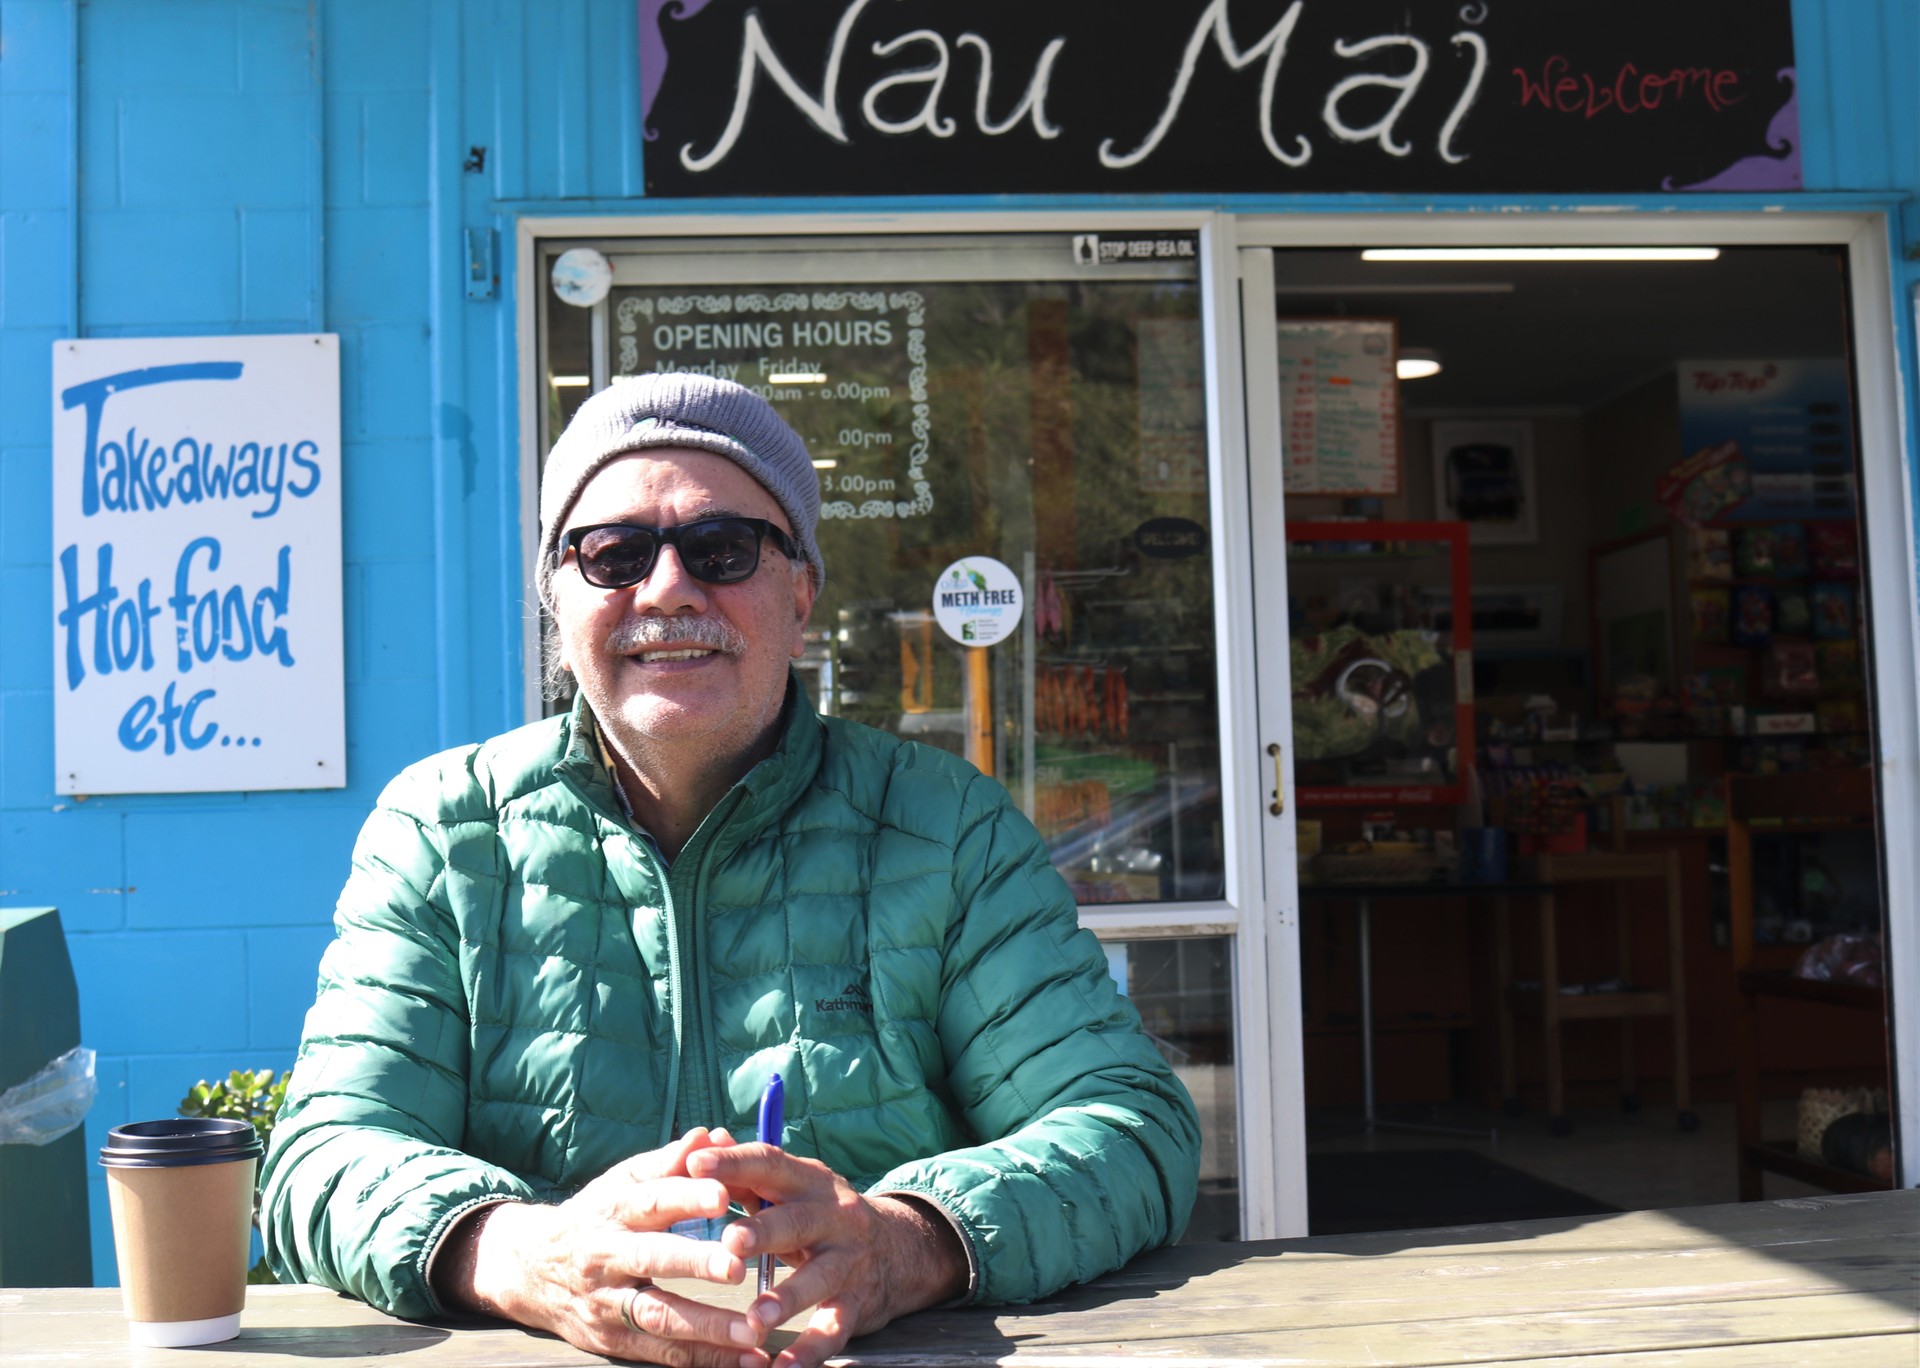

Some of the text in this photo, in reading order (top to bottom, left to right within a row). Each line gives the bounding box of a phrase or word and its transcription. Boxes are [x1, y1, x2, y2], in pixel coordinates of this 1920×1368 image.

[680, 0, 1487, 171] Nau Mai
[1100, 241, 1126, 258] STOP
[1128, 240, 1155, 257] DEEP
[1156, 240, 1177, 257] SEA
[653, 319, 893, 350] OPENING HOURS
[759, 356, 822, 378] Friday
[61, 361, 322, 519] Takeaways
[941, 589, 1015, 607] METH FREE
[58, 536, 295, 692] Hot food
